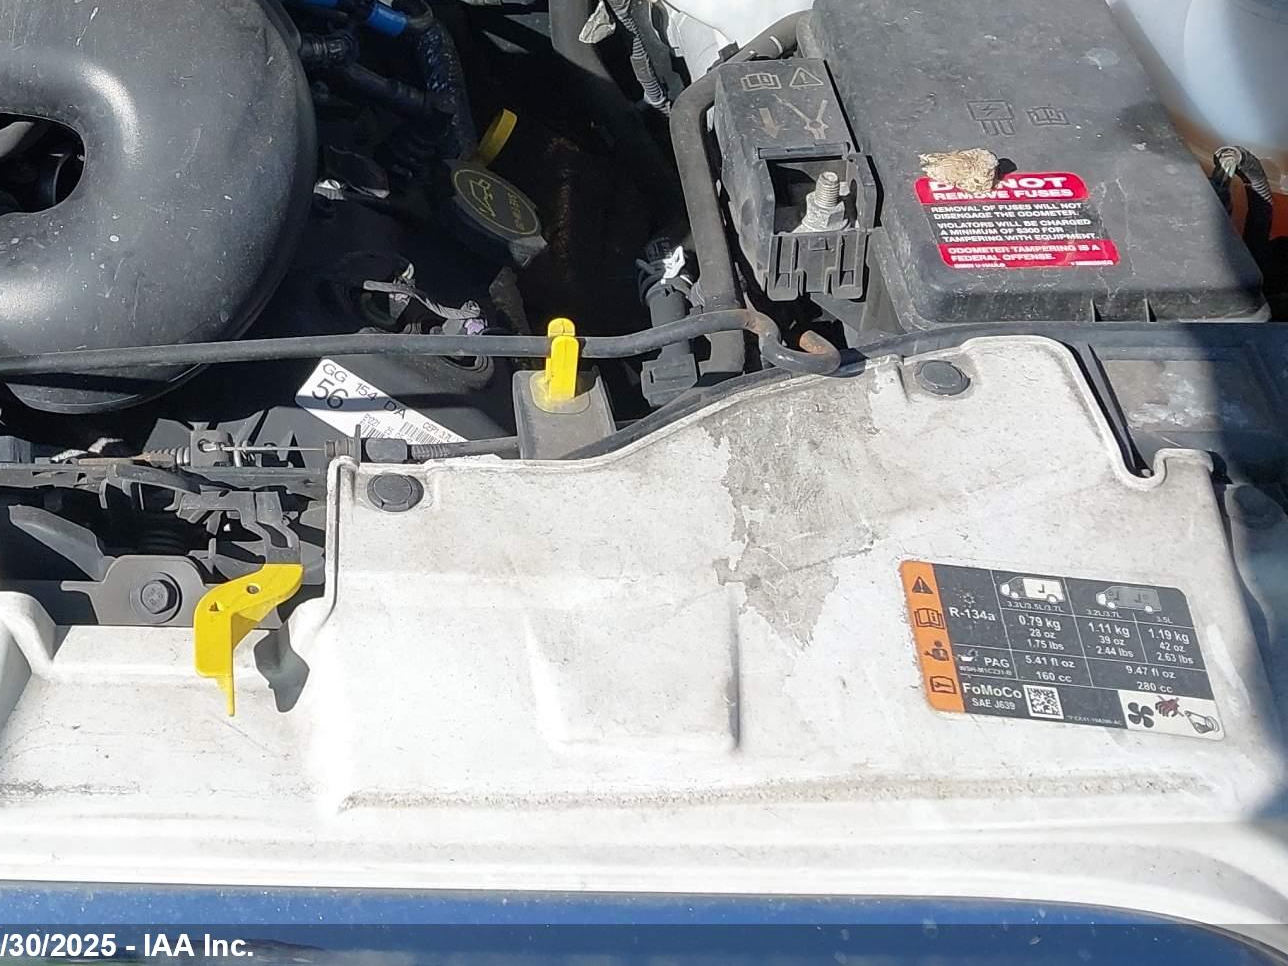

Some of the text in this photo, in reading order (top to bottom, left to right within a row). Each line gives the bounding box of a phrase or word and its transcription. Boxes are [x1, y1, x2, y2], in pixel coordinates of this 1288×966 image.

[997, 177, 1067, 189] NOT
[933, 189, 1074, 200] REMOVE FUSES
[931, 205, 980, 213] REMOVAL
[934, 212, 993, 220] DISENGAGE
[942, 235, 1004, 243] TAMPERING
[1034, 233, 1100, 241] EQUIPMENT.
[948, 246, 1010, 254] ODOMETER
[1012, 245, 1076, 253] TAMPERING
[951, 254, 1001, 262] FEDERAL
[312, 378, 349, 409] 56
[322, 363, 406, 419] GG 154 DA
[949, 607, 996, 621] R-134a
[1018, 614, 1062, 632] 0.79 kg
[1029, 628, 1042, 637] 28
[1088, 622, 1130, 638] 1.11 kg
[1098, 635, 1125, 646] 39 oz
[1148, 628, 1190, 645] 1.19 kg
[1027, 639, 1064, 651] 1.75 lbs
[1159, 641, 1186, 653] 42 oz
[1095, 645, 1134, 658] 2.44 lbs
[984, 657, 1010, 668] PAG
[1025, 655, 1076, 669] 5.41 fl oz
[1156, 652, 1194, 664] 2.63 lbs
[1035, 671, 1072, 682] 160 cc
[1125, 665, 1176, 679] 9.47 fl oz
[962, 682, 1023, 699] FoMoCo
[1136, 681, 1173, 693] 280 cc
[972, 697, 1016, 710] SAE J639
